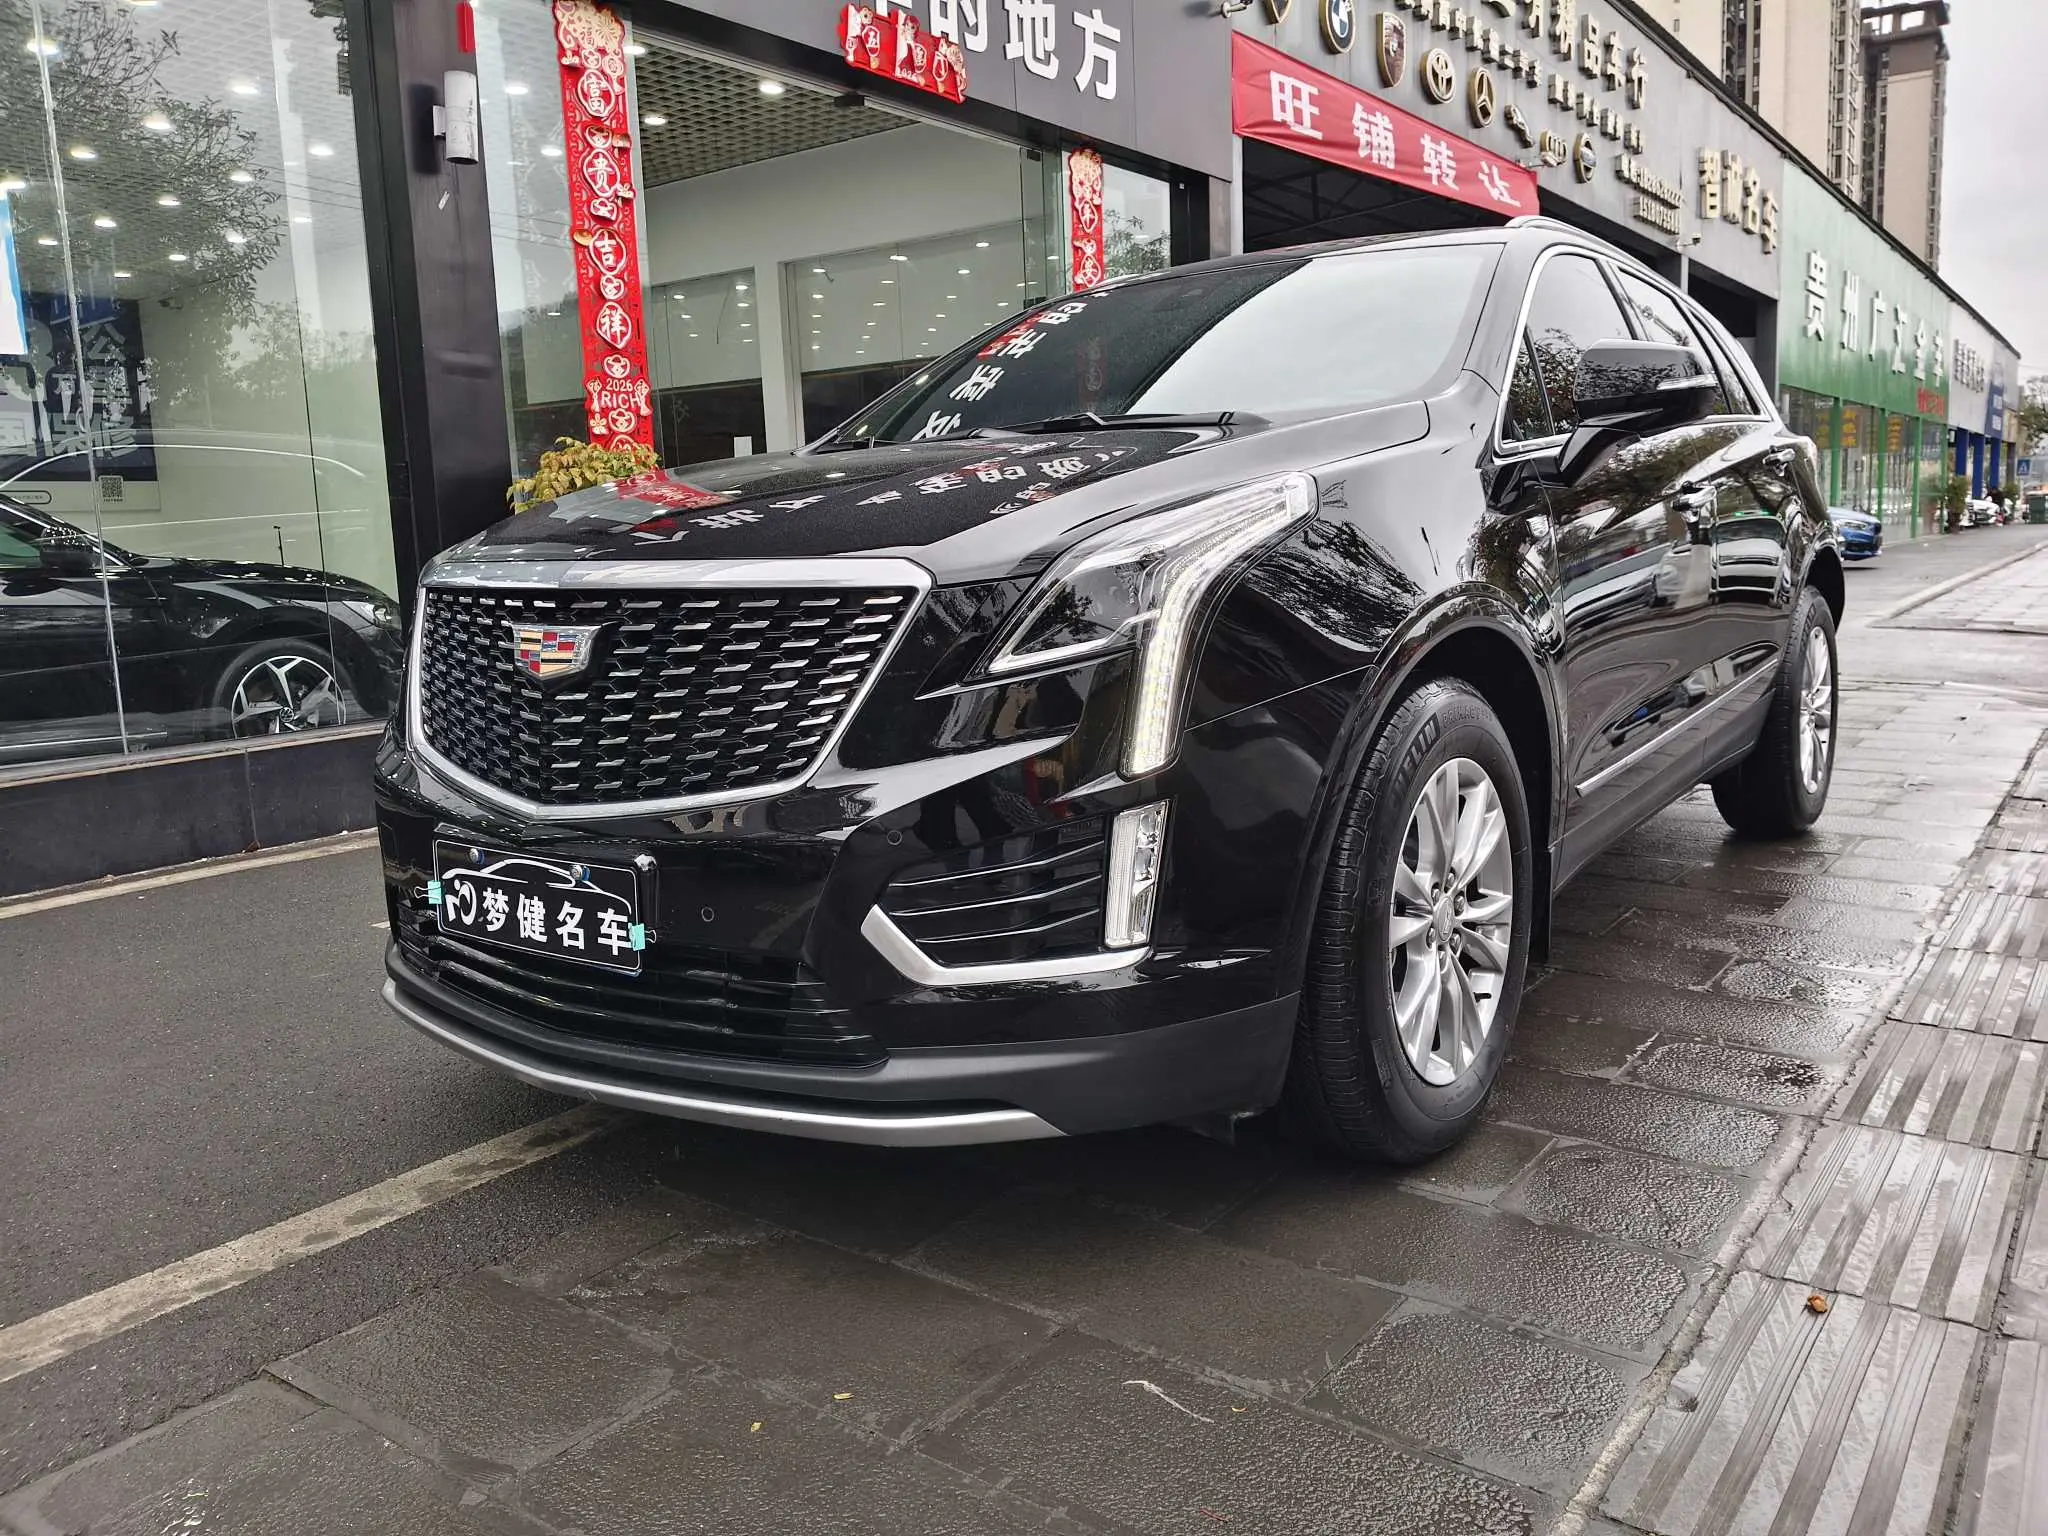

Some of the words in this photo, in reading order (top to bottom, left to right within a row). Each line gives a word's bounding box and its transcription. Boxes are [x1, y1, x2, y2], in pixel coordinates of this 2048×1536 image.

[876, 0, 1122, 100] 的地方
[1268, 70, 1522, 208] 旺铺转让
[605, 378, 633, 392] 2026
[481, 885, 633, 956] 梦健名车
